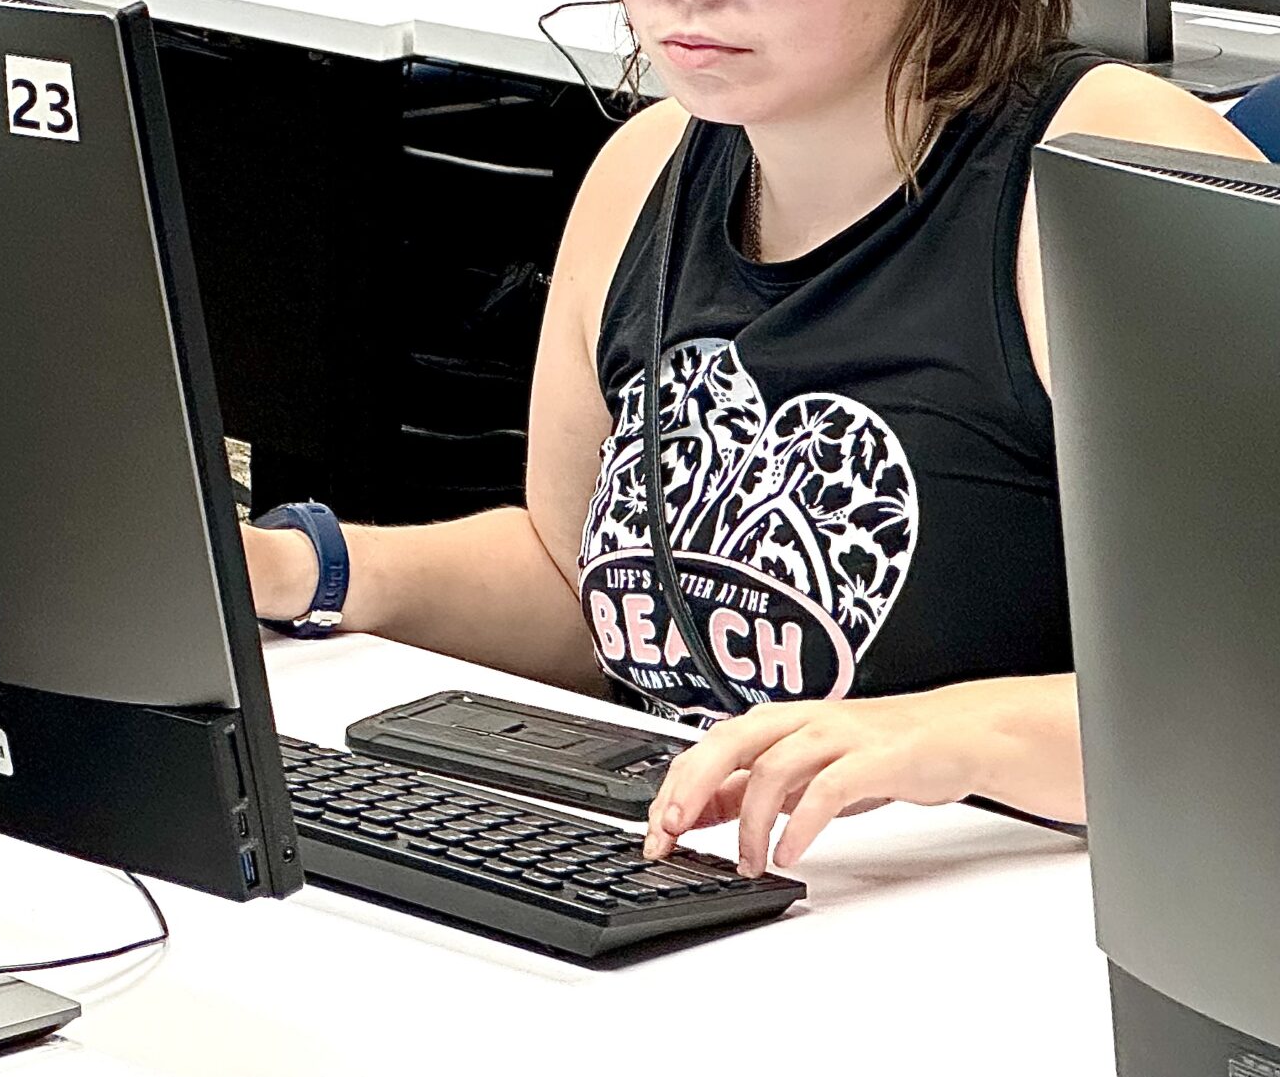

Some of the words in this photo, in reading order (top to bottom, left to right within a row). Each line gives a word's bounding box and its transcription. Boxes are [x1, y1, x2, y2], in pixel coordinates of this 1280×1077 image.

[10, 78, 74, 135] 23
[606, 567, 651, 589] LIFE'S
[658, 572, 713, 600] TTER
[716, 582, 736, 605] AT
[738, 586, 770, 614] THE
